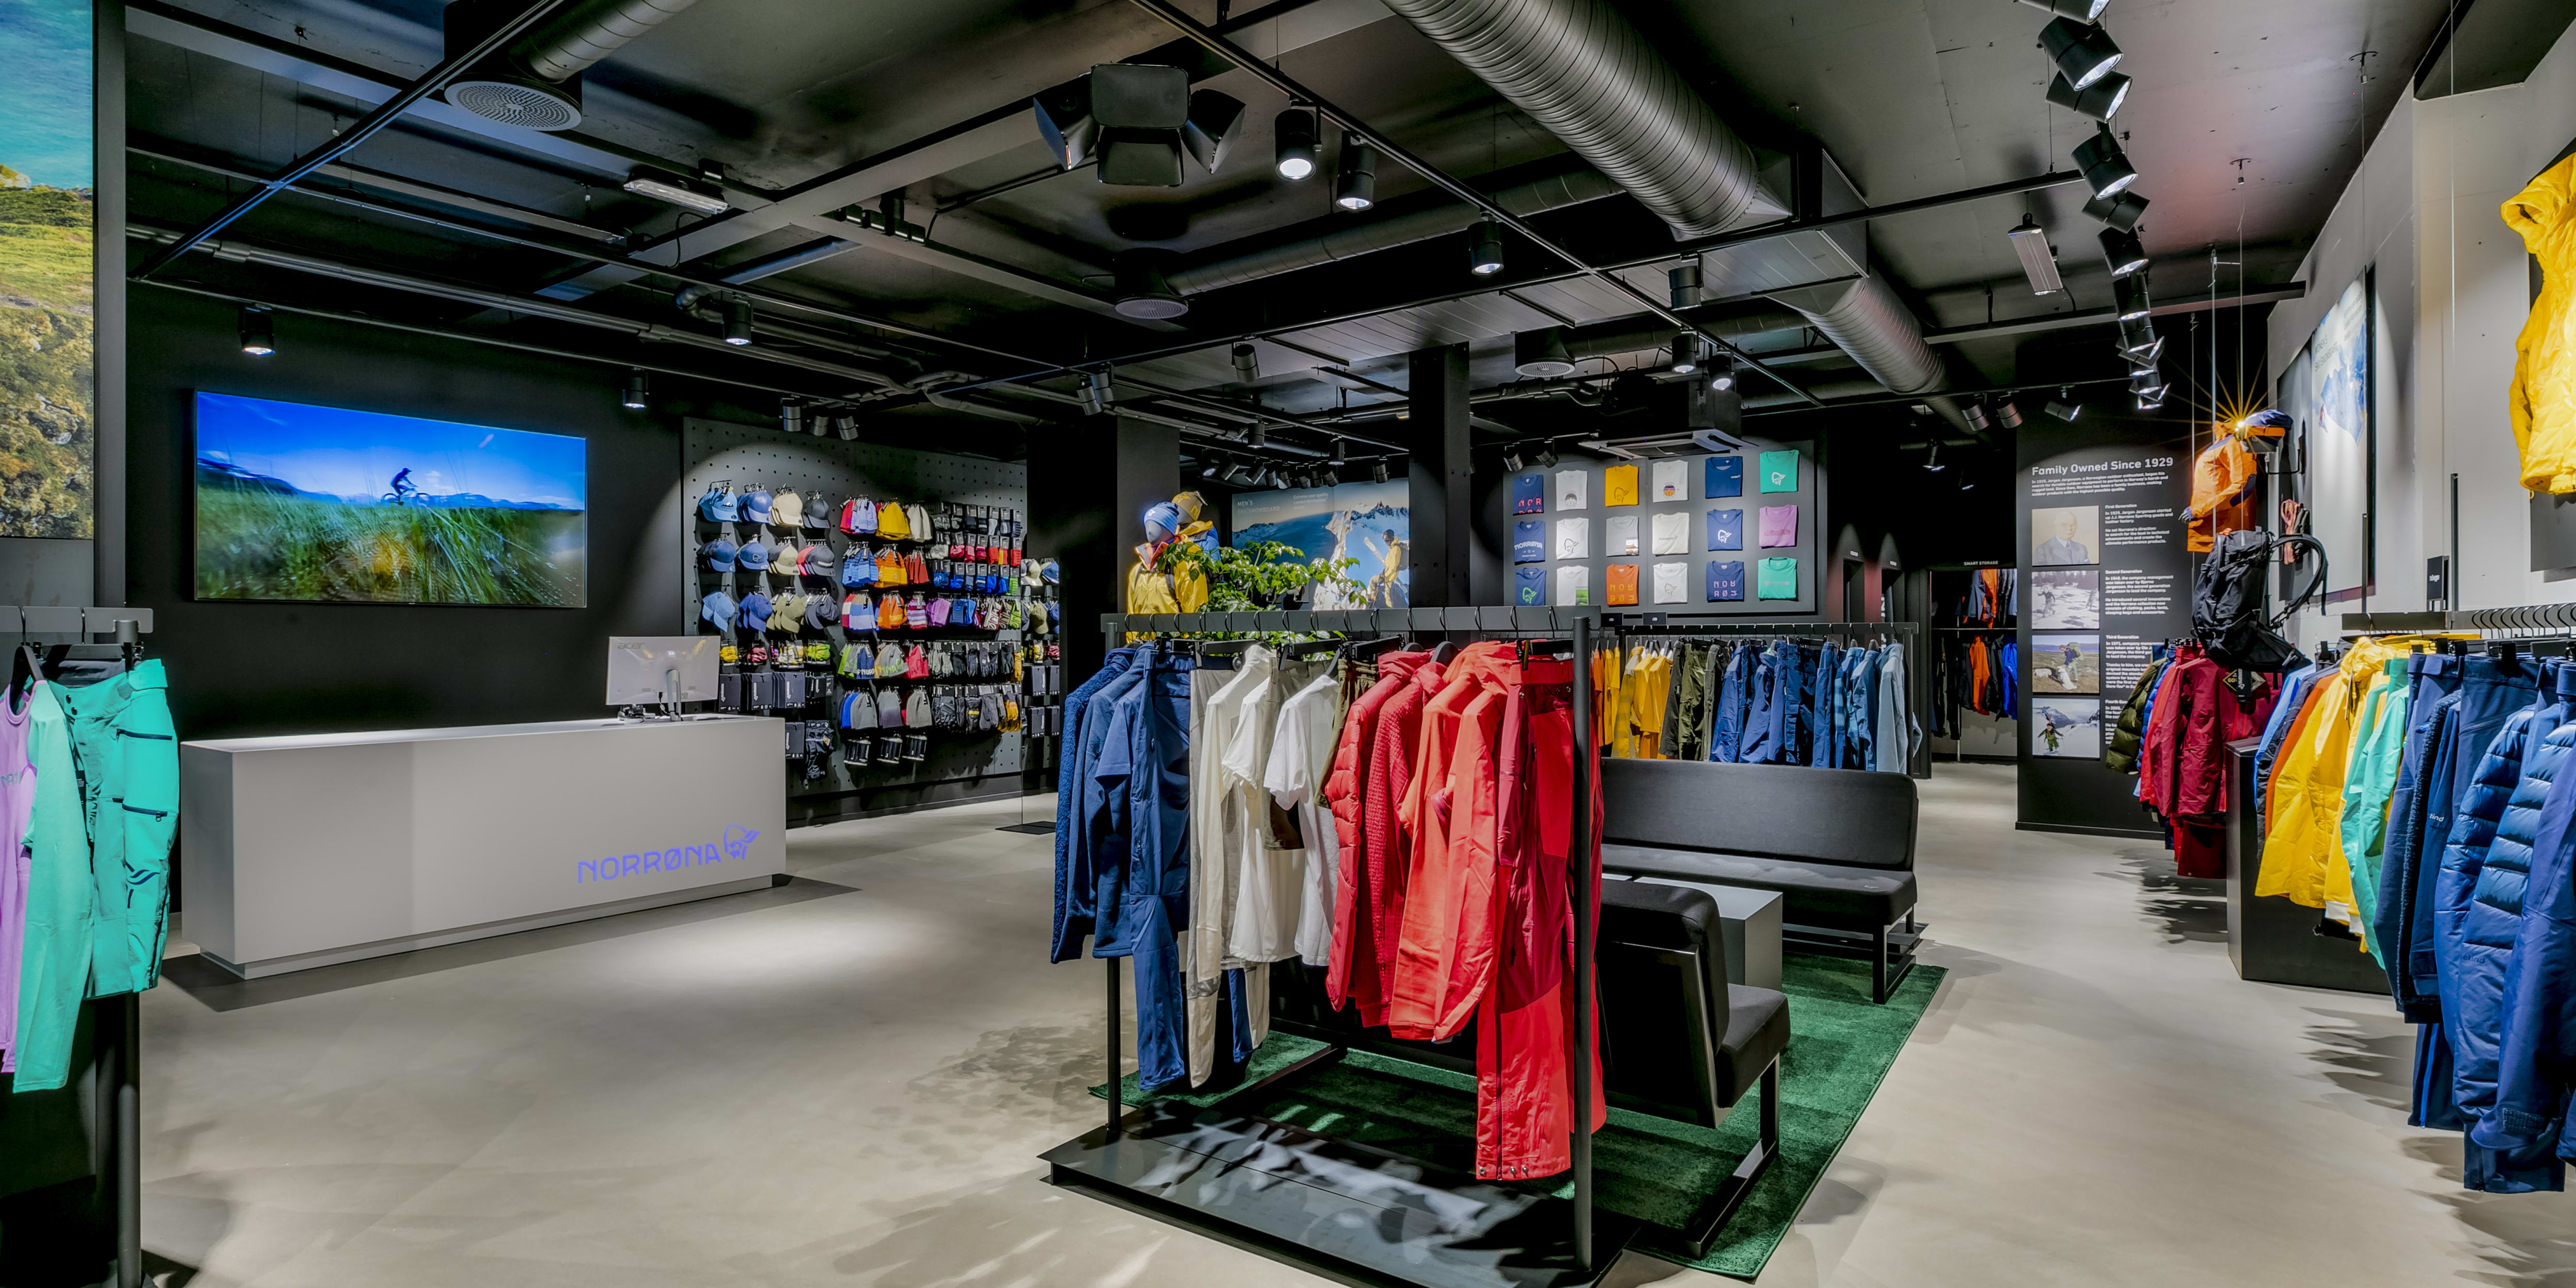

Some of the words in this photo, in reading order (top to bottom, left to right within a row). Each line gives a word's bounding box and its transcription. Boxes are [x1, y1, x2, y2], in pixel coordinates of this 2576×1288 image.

[2031, 465, 2069, 476] Family
[2071, 461, 2108, 473] Owned
[2110, 460, 2142, 470] Since
[2145, 457, 2174, 468] 1929
[1237, 506, 1280, 515] SKI/SNOWBOARD
[2429, 813, 2445, 822] tind
[578, 843, 722, 884] NORRØNA
